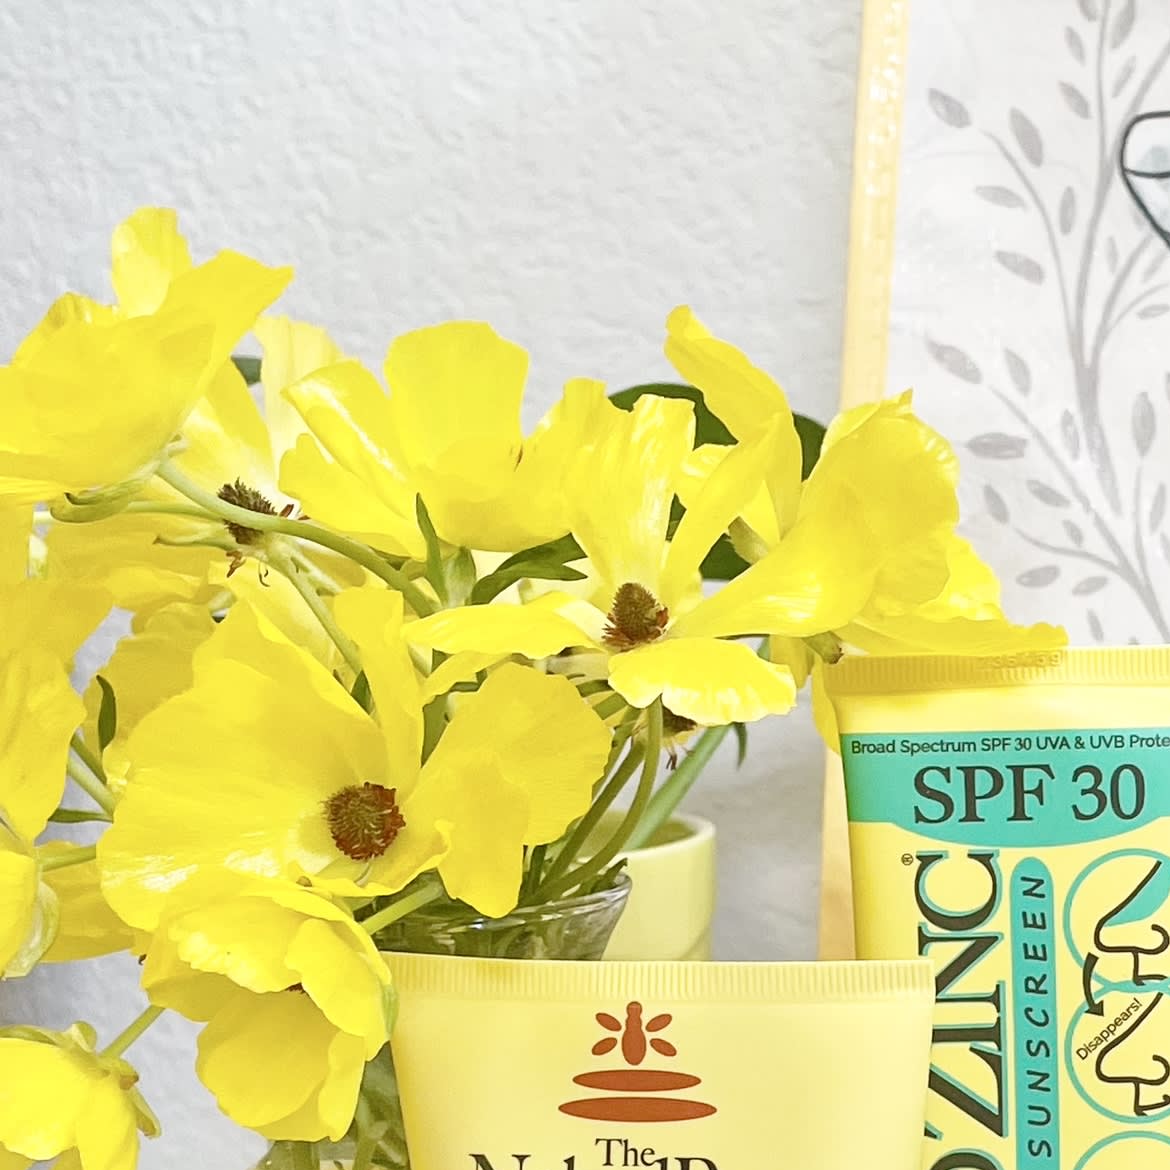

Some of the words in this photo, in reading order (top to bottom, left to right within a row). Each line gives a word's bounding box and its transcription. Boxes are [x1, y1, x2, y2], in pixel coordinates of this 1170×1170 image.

[851, 740, 897, 755] Broad
[900, 739, 977, 756] Spectrum
[980, 738, 1012, 752] SPF
[1014, 737, 1032, 752] 30
[1036, 737, 1071, 751] UVA
[1074, 736, 1085, 750] &
[1089, 735, 1125, 750] UVB
[913, 763, 1056, 824] SPF
[1071, 763, 1146, 821] 30
[1021, 876, 1052, 1158] SUNSCREEN
[1075, 997, 1144, 1061] Disappears!
[595, 1138, 656, 1167] The
